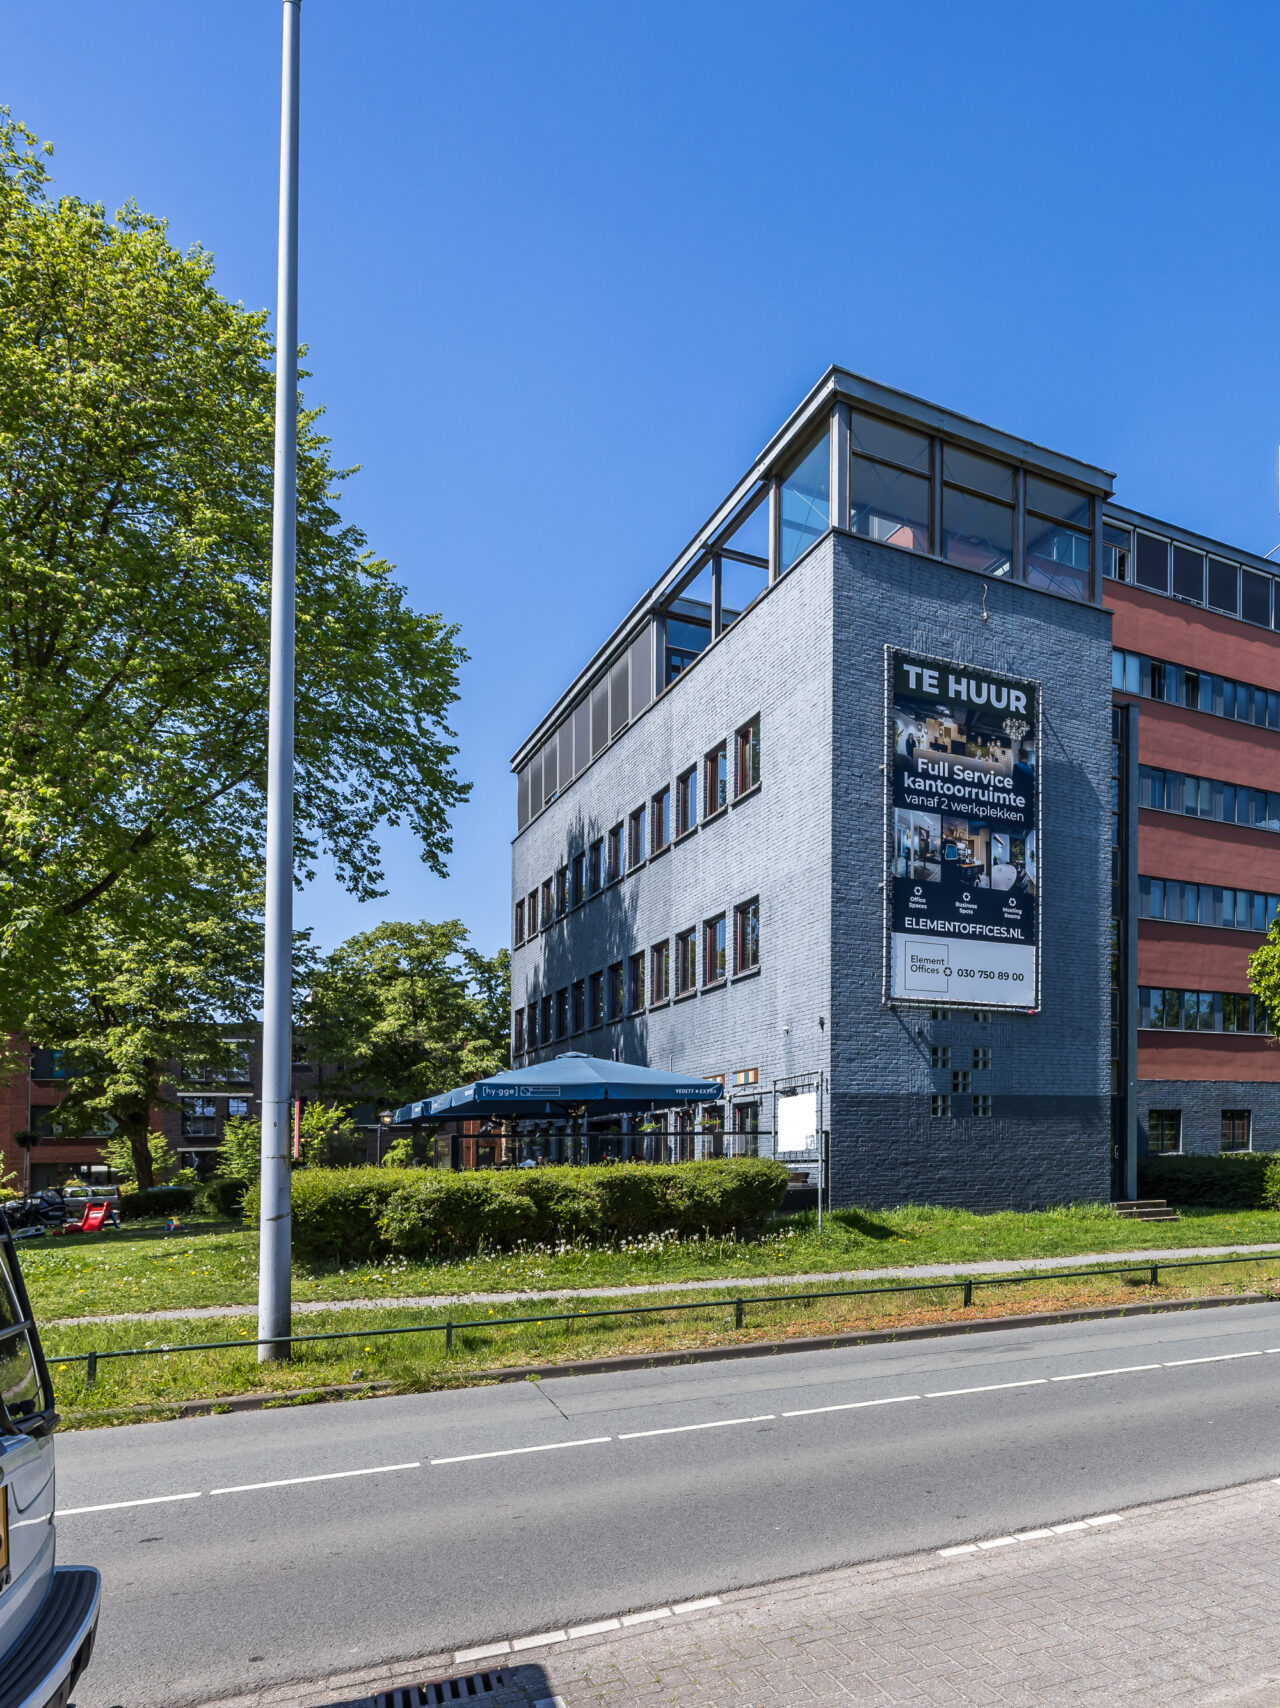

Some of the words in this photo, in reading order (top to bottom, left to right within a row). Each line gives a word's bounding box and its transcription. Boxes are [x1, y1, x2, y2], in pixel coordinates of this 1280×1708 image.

[903, 664, 940, 695] TE
[948, 674, 1027, 715] HUUR
[917, 758, 949, 778] Full
[953, 765, 1014, 789] Service
[904, 771, 1026, 808] kantoorruimte
[904, 793, 939, 808] vanaf
[941, 798, 949, 810] 2
[950, 801, 1025, 822] werkplekken
[908, 902, 928, 910] Spaces
[955, 901, 978, 909] Business
[958, 907, 974, 915] Spots
[904, 917, 1025, 940] ELEMENTOFFICES.NL
[910, 954, 945, 966] Element
[910, 964, 940, 975] Offices
[957, 968, 976, 978] 030
[978, 969, 995, 980] 750
[997, 971, 1010, 981] 89
[1012, 972, 1025, 982] 00
